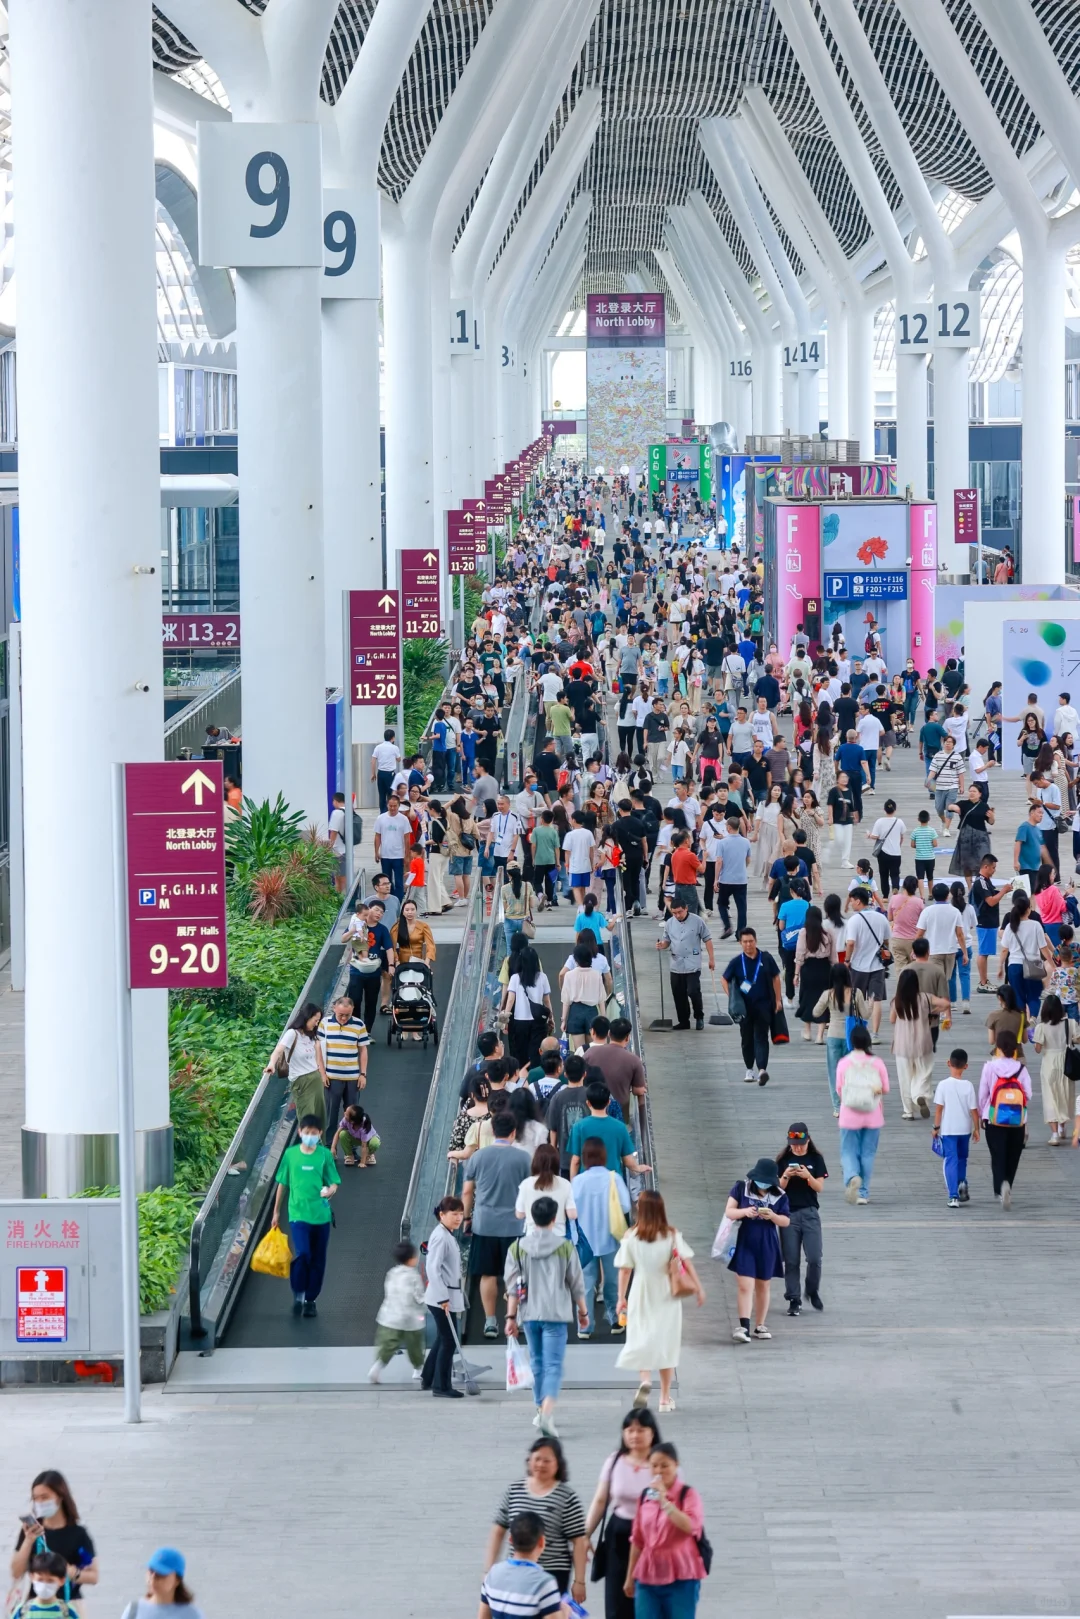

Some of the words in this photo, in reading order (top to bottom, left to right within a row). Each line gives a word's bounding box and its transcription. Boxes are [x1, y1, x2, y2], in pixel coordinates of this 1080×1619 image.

[245, 151, 290, 238] 9
[324, 210, 356, 277] 9
[595, 302, 656, 314] 北登录大厅
[595, 317, 624, 327] North
[627, 316, 656, 329] Lobby
[938, 302, 970, 336] 12
[899, 313, 928, 344] 12
[800, 341, 819, 363] 14
[652, 448, 660, 460] G
[787, 515, 798, 543] F
[923, 509, 933, 538] F
[475, 544, 486, 553] 20
[451, 561, 475, 571] 11-20
[832, 578, 843, 595] P
[406, 620, 438, 633] 11-20
[356, 683, 397, 699] 11-20
[166, 828, 217, 839] 北登录大厅
[166, 841, 191, 850] North
[191, 840, 217, 852] Lobby
[142, 891, 152, 903] P
[159, 898, 170, 909] M
[176, 926, 197, 937] 展厅
[200, 926, 219, 936] Halls
[149, 942, 220, 975] 9-20
[7, 1219, 80, 1239] 消火栓
